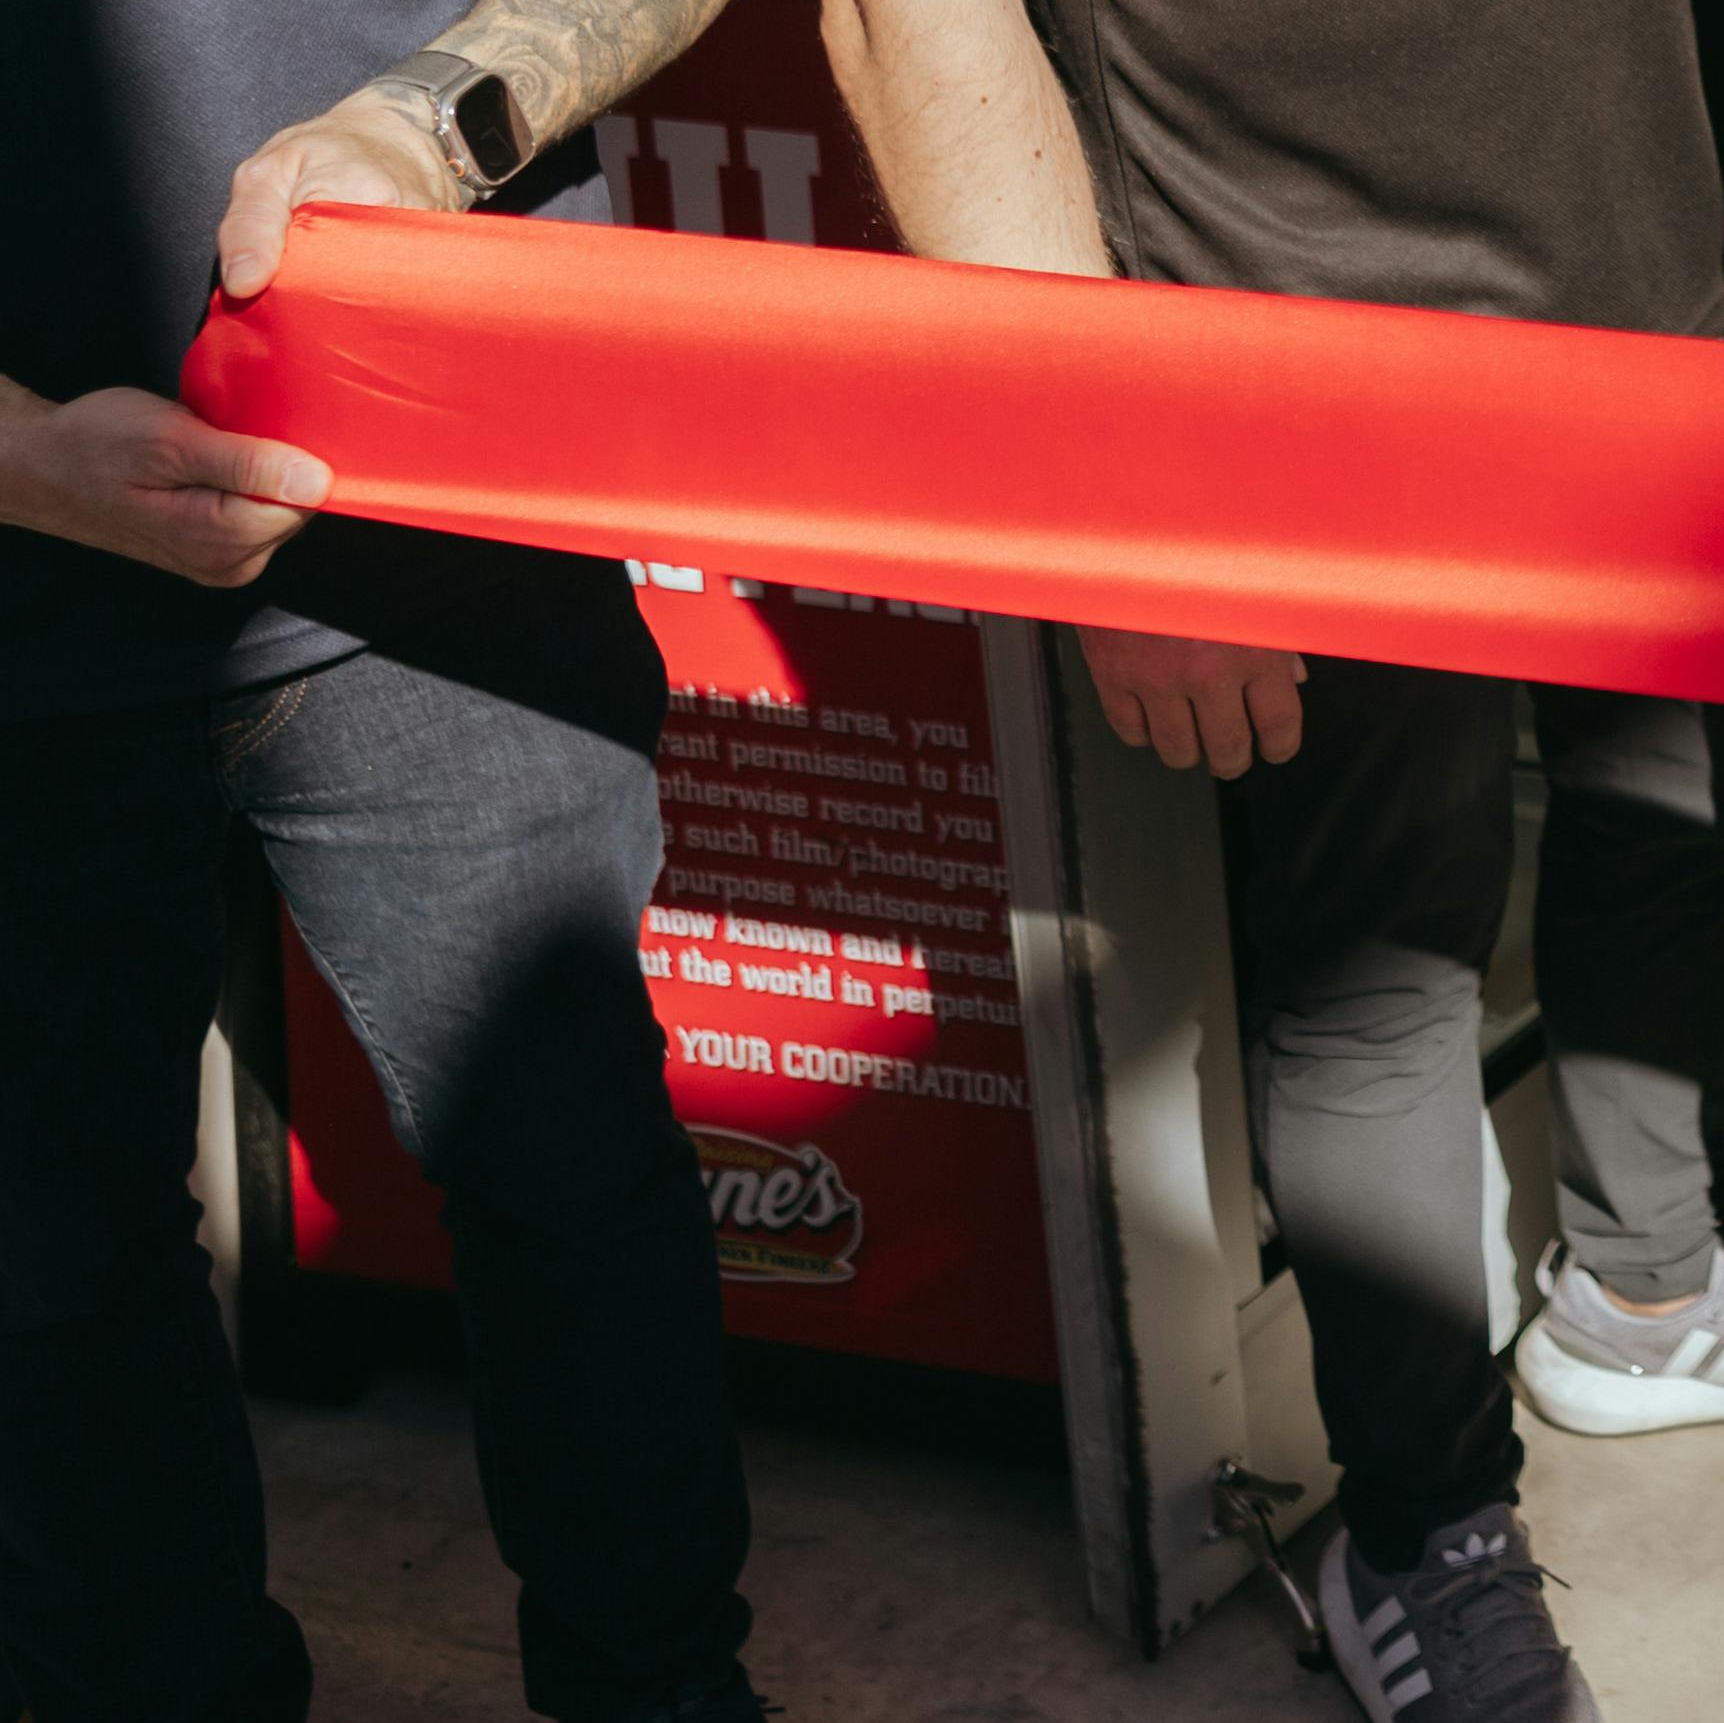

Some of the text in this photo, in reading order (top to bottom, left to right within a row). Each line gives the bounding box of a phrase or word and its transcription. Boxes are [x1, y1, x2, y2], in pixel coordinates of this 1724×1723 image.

[748, 685, 810, 728] this
[821, 707, 898, 744] area,
[910, 719, 971, 751] you
[729, 738, 908, 787] permission
[918, 759, 948, 792] to
[958, 763, 998, 799] fil
[684, 817, 761, 859] such
[820, 792, 925, 835] record
[935, 815, 994, 846] you
[668, 864, 797, 908] purpose
[805, 880, 992, 933] whatsoever
[648, 905, 719, 940] now
[724, 908, 834, 957] known
[840, 931, 905, 967] and
[678, 945, 733, 987] the
[740, 962, 834, 1003] world
[841, 970, 876, 1008] in
[676, 1024, 1034, 1112] YOUR COOPERATION.
